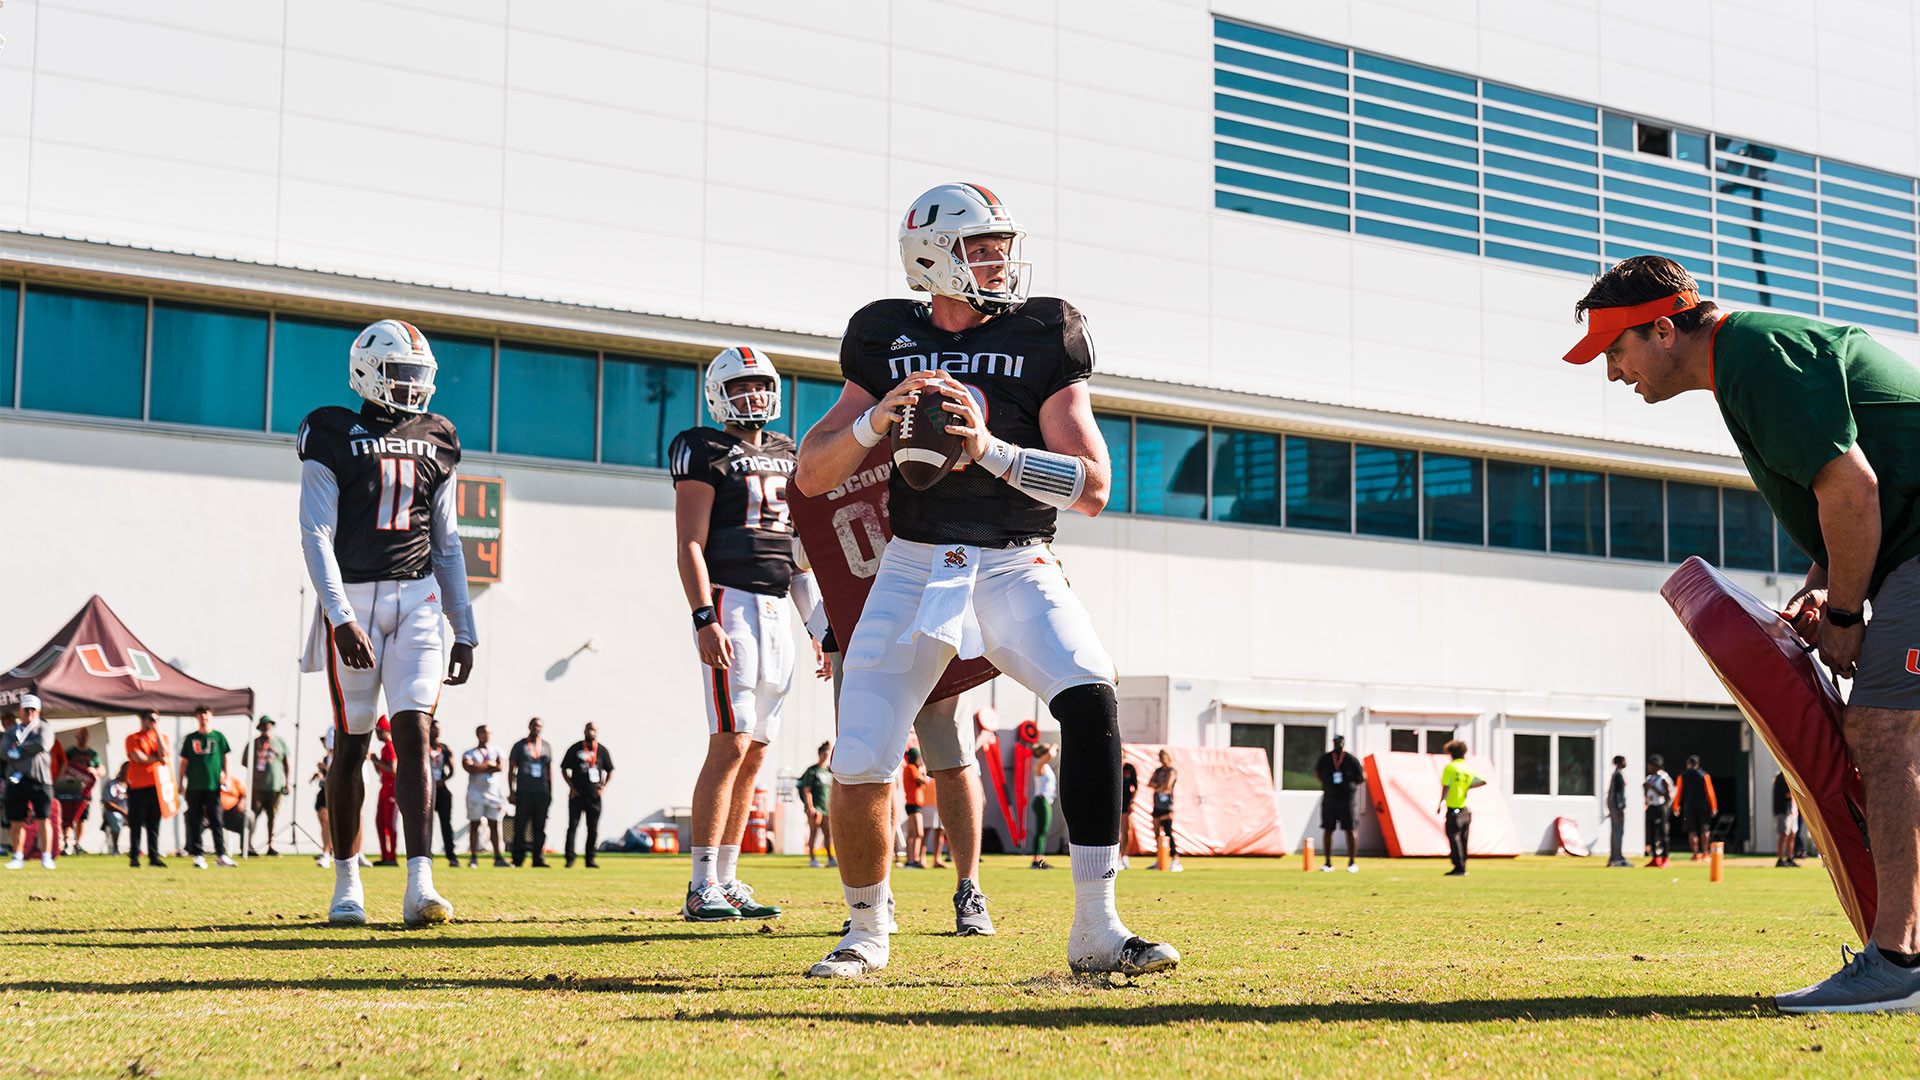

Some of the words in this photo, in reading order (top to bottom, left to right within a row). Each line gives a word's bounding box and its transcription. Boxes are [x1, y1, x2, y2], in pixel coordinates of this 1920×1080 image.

[890, 341, 917, 350] adidas
[376, 457, 415, 531] 11
[827, 461, 893, 500] SCOO
[832, 489, 890, 579] 0
[477, 541, 498, 576] 4
[75, 643, 161, 681] U
